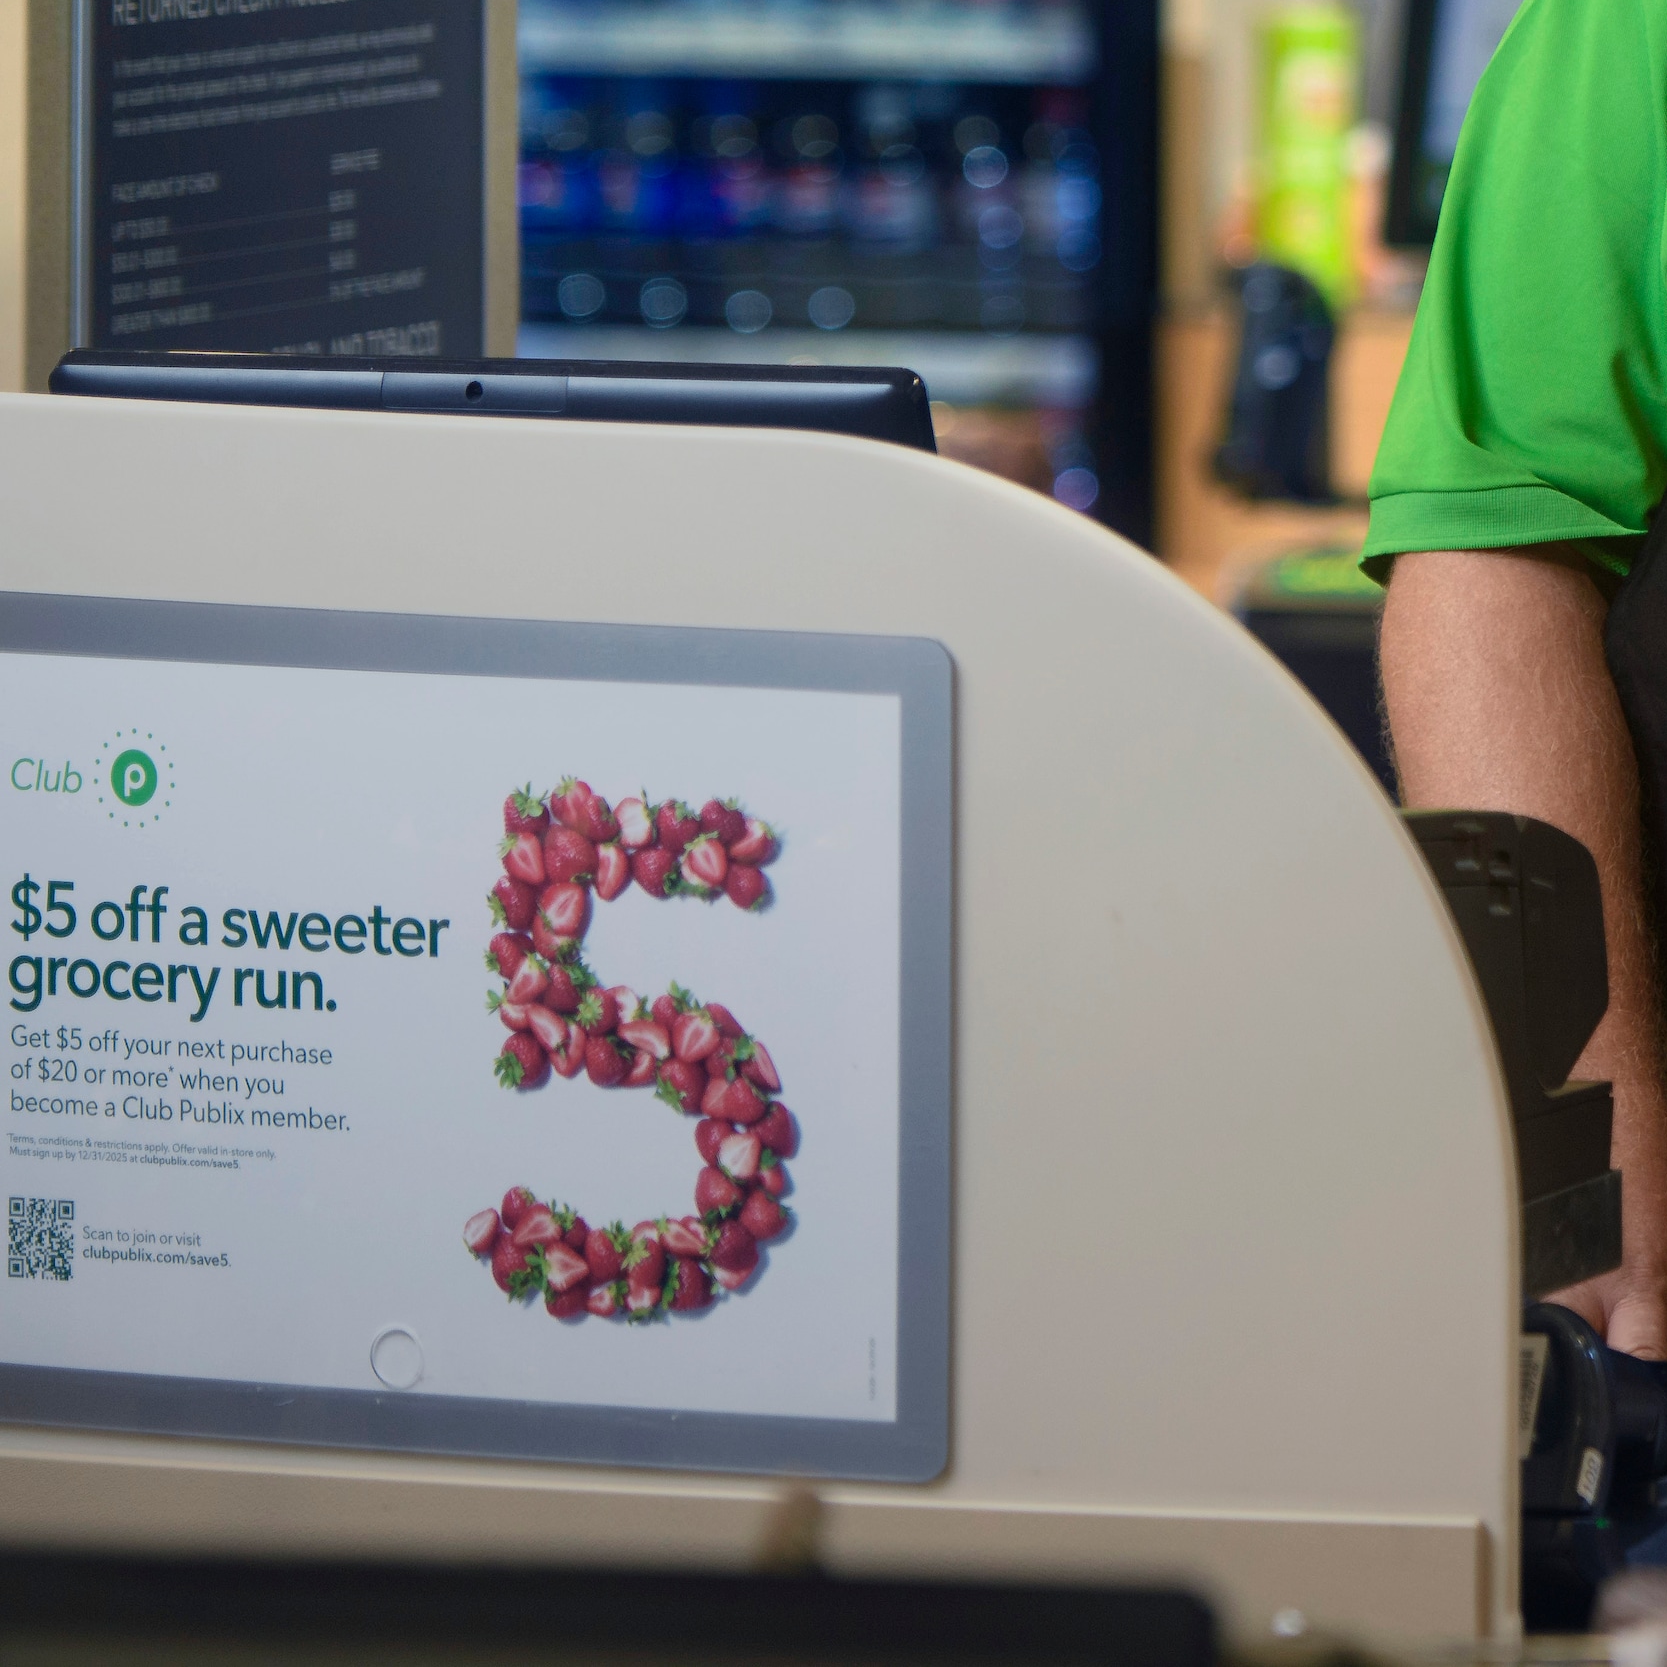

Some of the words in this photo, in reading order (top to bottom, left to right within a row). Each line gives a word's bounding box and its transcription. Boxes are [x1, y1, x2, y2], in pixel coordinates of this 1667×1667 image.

[10, 758, 83, 794] Club
[10, 873, 77, 942] $5
[90, 885, 169, 943] off
[179, 905, 208, 946] a
[220, 905, 450, 958] sweeter
[8, 954, 221, 1023] grocery
[233, 967, 337, 1012] run.
[10, 1024, 51, 1049] Get
[56, 1026, 83, 1052] $5
[88, 1030, 120, 1053] off
[123, 1037, 172, 1060] your
[177, 1040, 226, 1060] next
[231, 1041, 334, 1067] purchase
[10, 1057, 33, 1079] of
[38, 1058, 78, 1083] $20
[83, 1067, 107, 1084] or
[179, 1069, 239, 1093] when
[244, 1078, 285, 1099] you
[10, 1089, 99, 1117] become
[104, 1099, 117, 1118] a
[122, 1095, 174, 1121] Club
[179, 1099, 245, 1126] Publix
[250, 1106, 351, 1132] member.
[8, 1133, 36, 1146] Terms,
[38, 1135, 84, 1148] conditions
[84, 1138, 92, 1148] &
[93, 1139, 143, 1152] restrictions
[144, 1142, 170, 1154] apply.
[172, 1143, 197, 1155] Offer
[198, 1145, 219, 1157] valid
[220, 1146, 254, 1158] in-store
[255, 1148, 277, 1161] only.
[9, 1145, 31, 1157] Must
[32, 1148, 51, 1161] sign
[52, 1151, 64, 1161] up
[65, 1149, 76, 1162] by
[78, 1150, 128, 1163] 12/31/2025
[129, 1154, 138, 1163] at
[139, 1154, 241, 1170] clubpublix.com/save5.
[82, 1225, 113, 1242] Scan
[116, 1229, 130, 1242] to
[131, 1229, 156, 1246] join
[159, 1233, 174, 1245] or
[175, 1232, 202, 1247] visit
[82, 1245, 232, 1268] clubpublix.com/save5.
